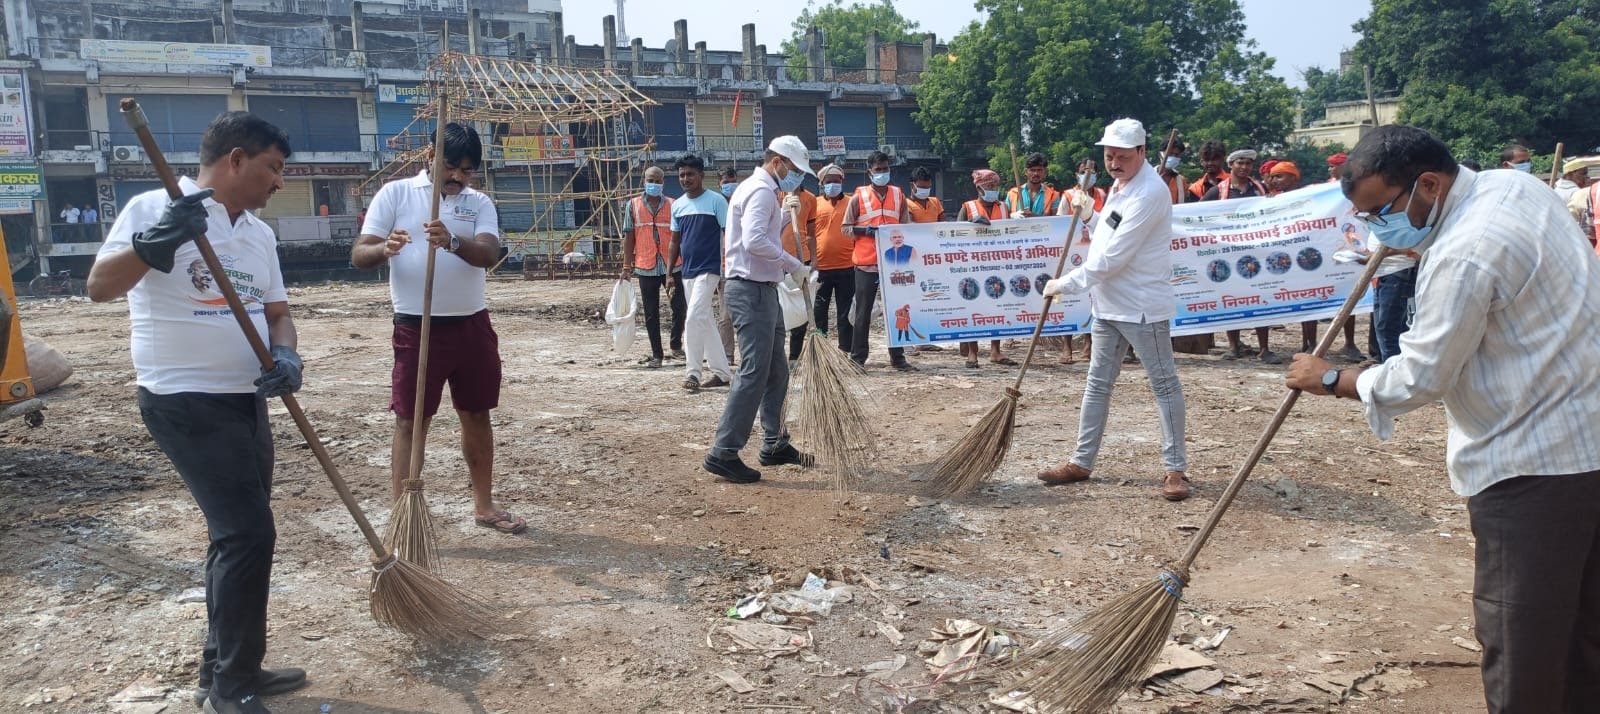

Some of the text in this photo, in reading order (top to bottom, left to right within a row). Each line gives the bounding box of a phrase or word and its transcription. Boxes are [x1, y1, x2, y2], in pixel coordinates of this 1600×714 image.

[0, 173, 39, 184] कल्स
[1191, 234, 1217, 247] घण्टे
[1220, 226, 1281, 243] महासफाई
[1284, 216, 1337, 235] अभियान
[922, 253, 942, 266] 155
[944, 249, 968, 264] घण्टे
[971, 246, 1022, 262] महासफाई
[223, 268, 253, 282] वच्छता
[1186, 300, 1217, 313] नगर
[1273, 285, 1335, 301] गोरखपुर
[940, 317, 968, 329] नगर
